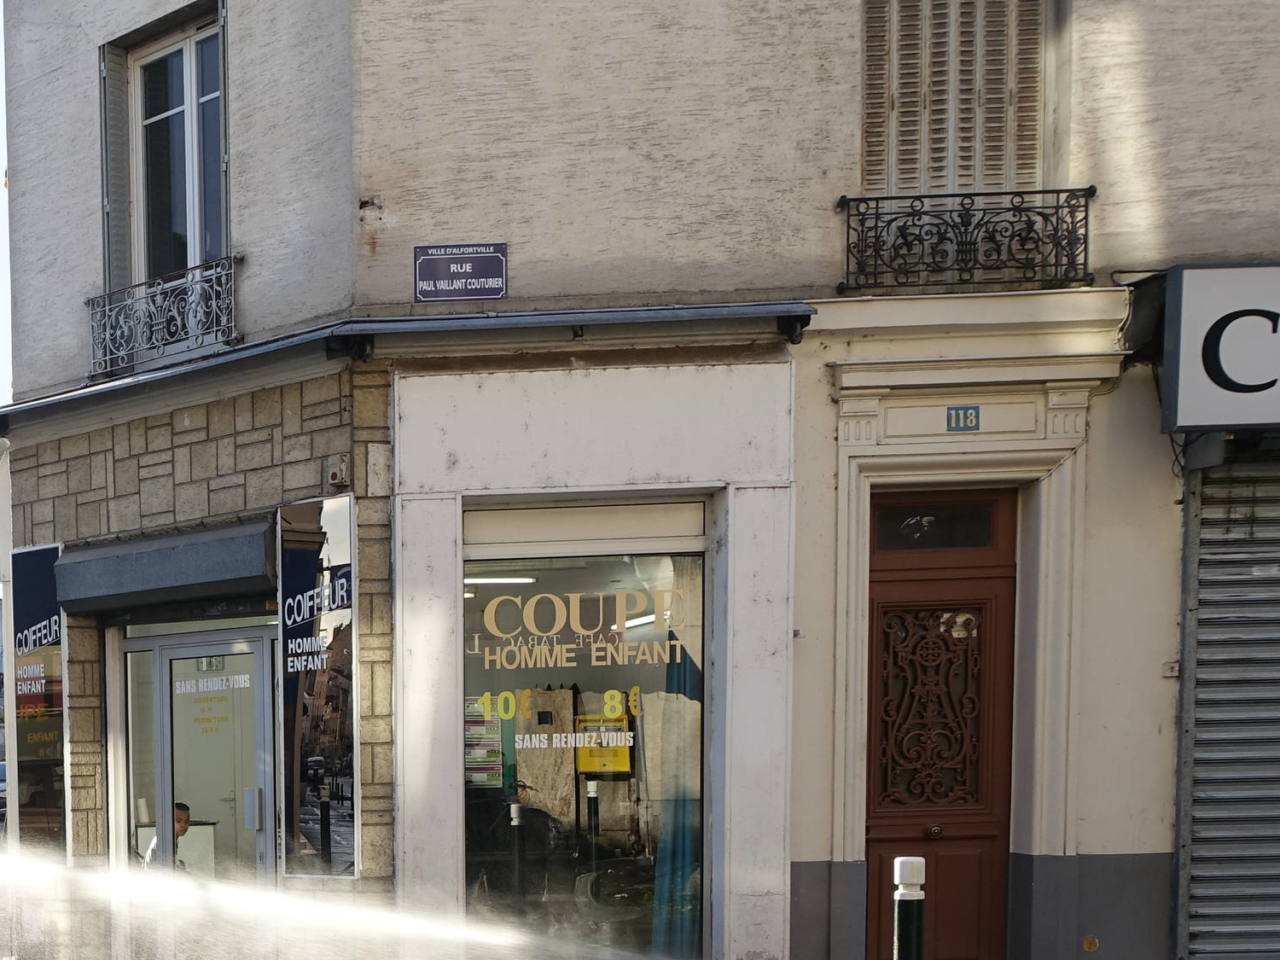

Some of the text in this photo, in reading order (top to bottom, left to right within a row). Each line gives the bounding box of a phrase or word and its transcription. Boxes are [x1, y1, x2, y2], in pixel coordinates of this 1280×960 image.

[446, 246, 494, 254] D'ALFORTVILLE
[450, 263, 472, 273] RUE
[419, 278, 503, 291] PAUL VAILLANT COUTURIER
[950, 409, 977, 427] 118
[285, 578, 347, 625] COIFFEUR
[484, 589, 688, 638] COUPE
[15, 615, 60, 656] COIFFEUR
[288, 635, 327, 654] HOMME
[288, 654, 328, 672] ENFANT
[484, 641, 684, 670] HOMME ENFANT
[17, 664, 45, 679] HOMME
[17, 680, 46, 694] ENFANT
[176, 674, 250, 694] SANS RENDEZ-VOUS
[515, 732, 634, 749] SANS RENDEZ-VOUS
